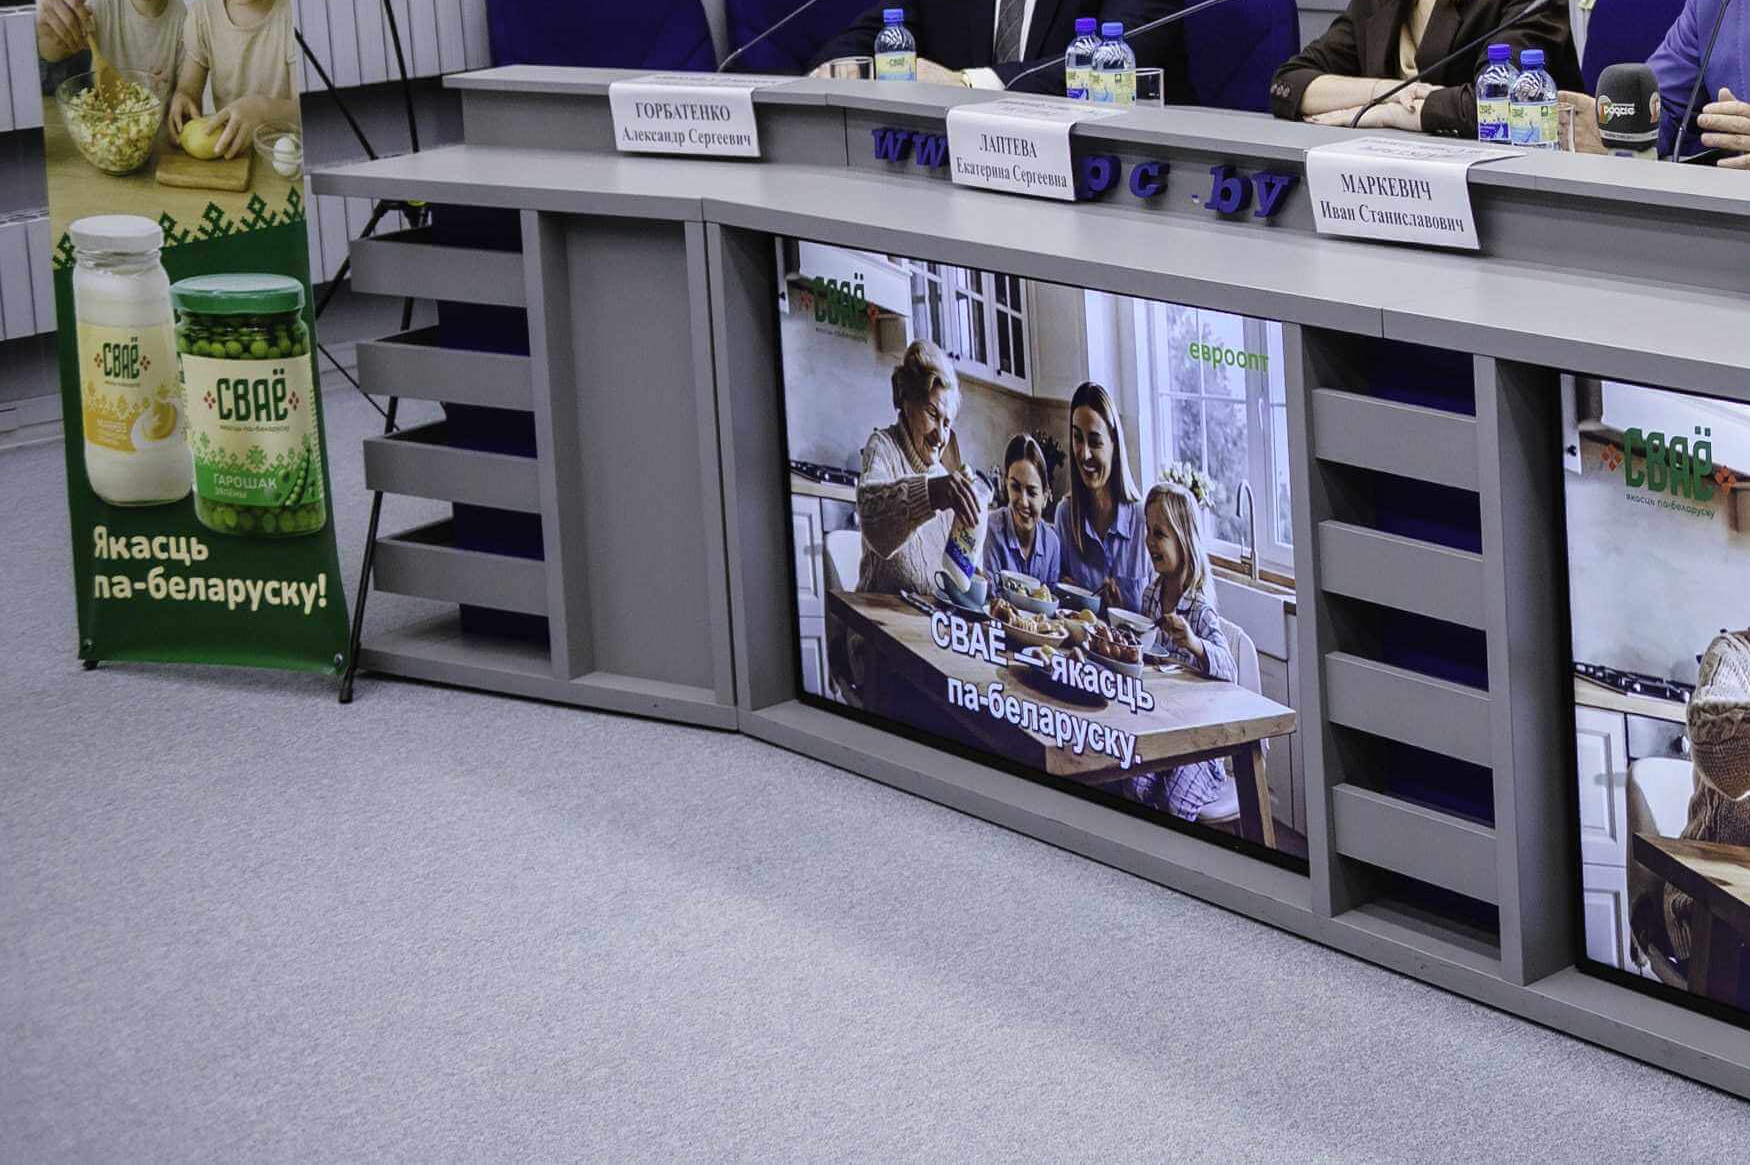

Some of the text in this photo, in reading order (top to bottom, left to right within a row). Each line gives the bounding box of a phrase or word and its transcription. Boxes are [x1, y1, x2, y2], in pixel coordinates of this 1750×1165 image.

[635, 101, 731, 123] ГОРБАТЕНКО
[622, 126, 752, 149] Александр Сергеевич
[979, 133, 1038, 159] ЛАПТЕВА
[956, 156, 1069, 188] Екатерина Сергеевна
[1341, 173, 1433, 202] МАРКЕВИЧ
[1320, 200, 1465, 234] Иван Станиславович
[103, 336, 141, 380] СВАЁ
[1188, 339, 1270, 373] евроопт
[216, 368, 289, 423] СВАЁ
[213, 472, 278, 491] ГАРОШАК
[1624, 425, 1714, 504] СВАЁ
[93, 524, 210, 562] Якасць
[93, 567, 329, 616] па-беларуску!
[929, 610, 1156, 714] СВАЁ якасць
[946, 675, 1143, 770] па-беларуску.
